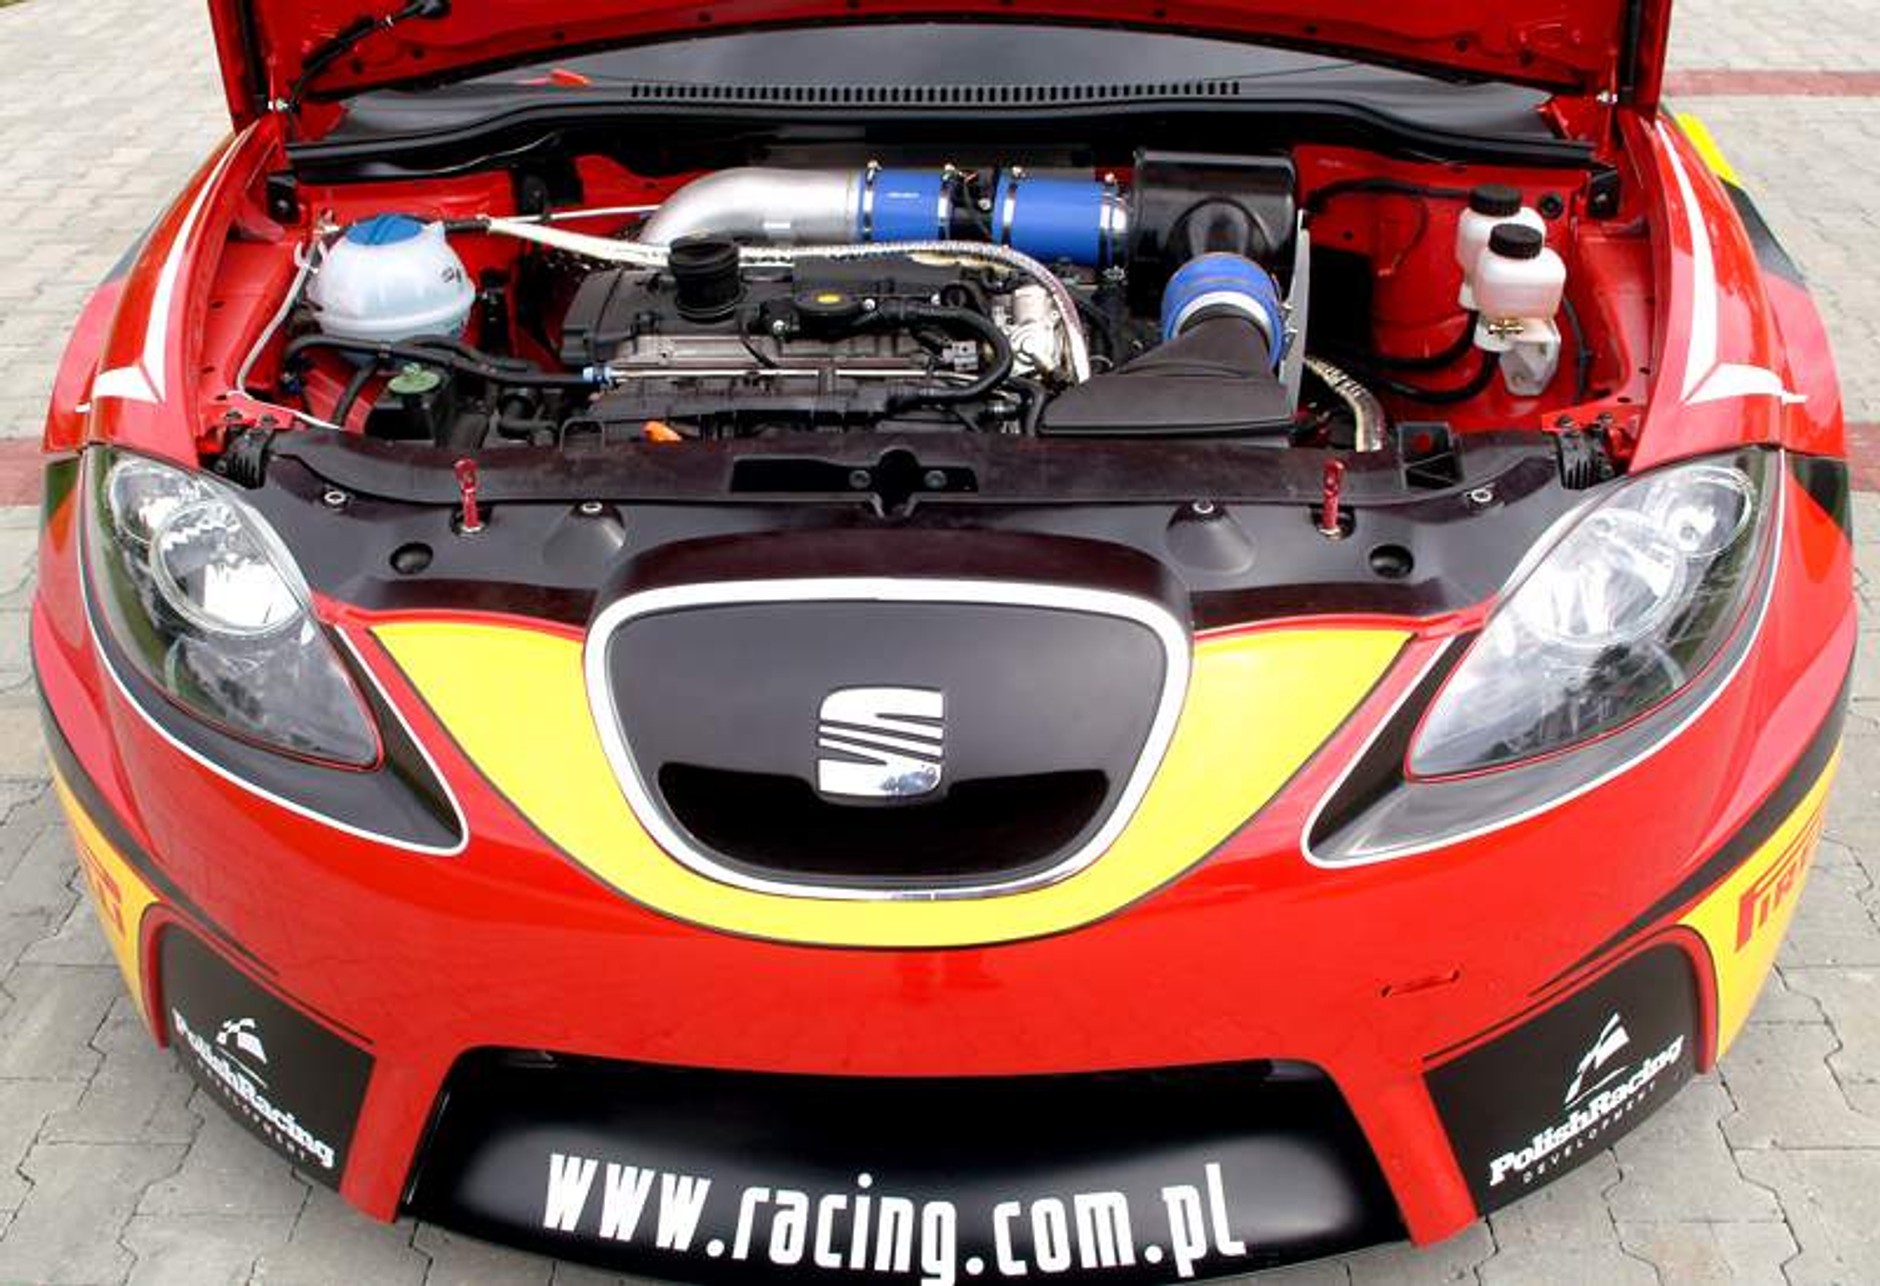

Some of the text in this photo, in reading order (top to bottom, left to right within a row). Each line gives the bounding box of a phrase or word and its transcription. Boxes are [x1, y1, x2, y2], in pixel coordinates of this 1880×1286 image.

[171, 1006, 335, 1169] PolishRacing
[1489, 1034, 1686, 1187] PolishRacing
[543, 1152, 1248, 1286] www.racing.com.pl
